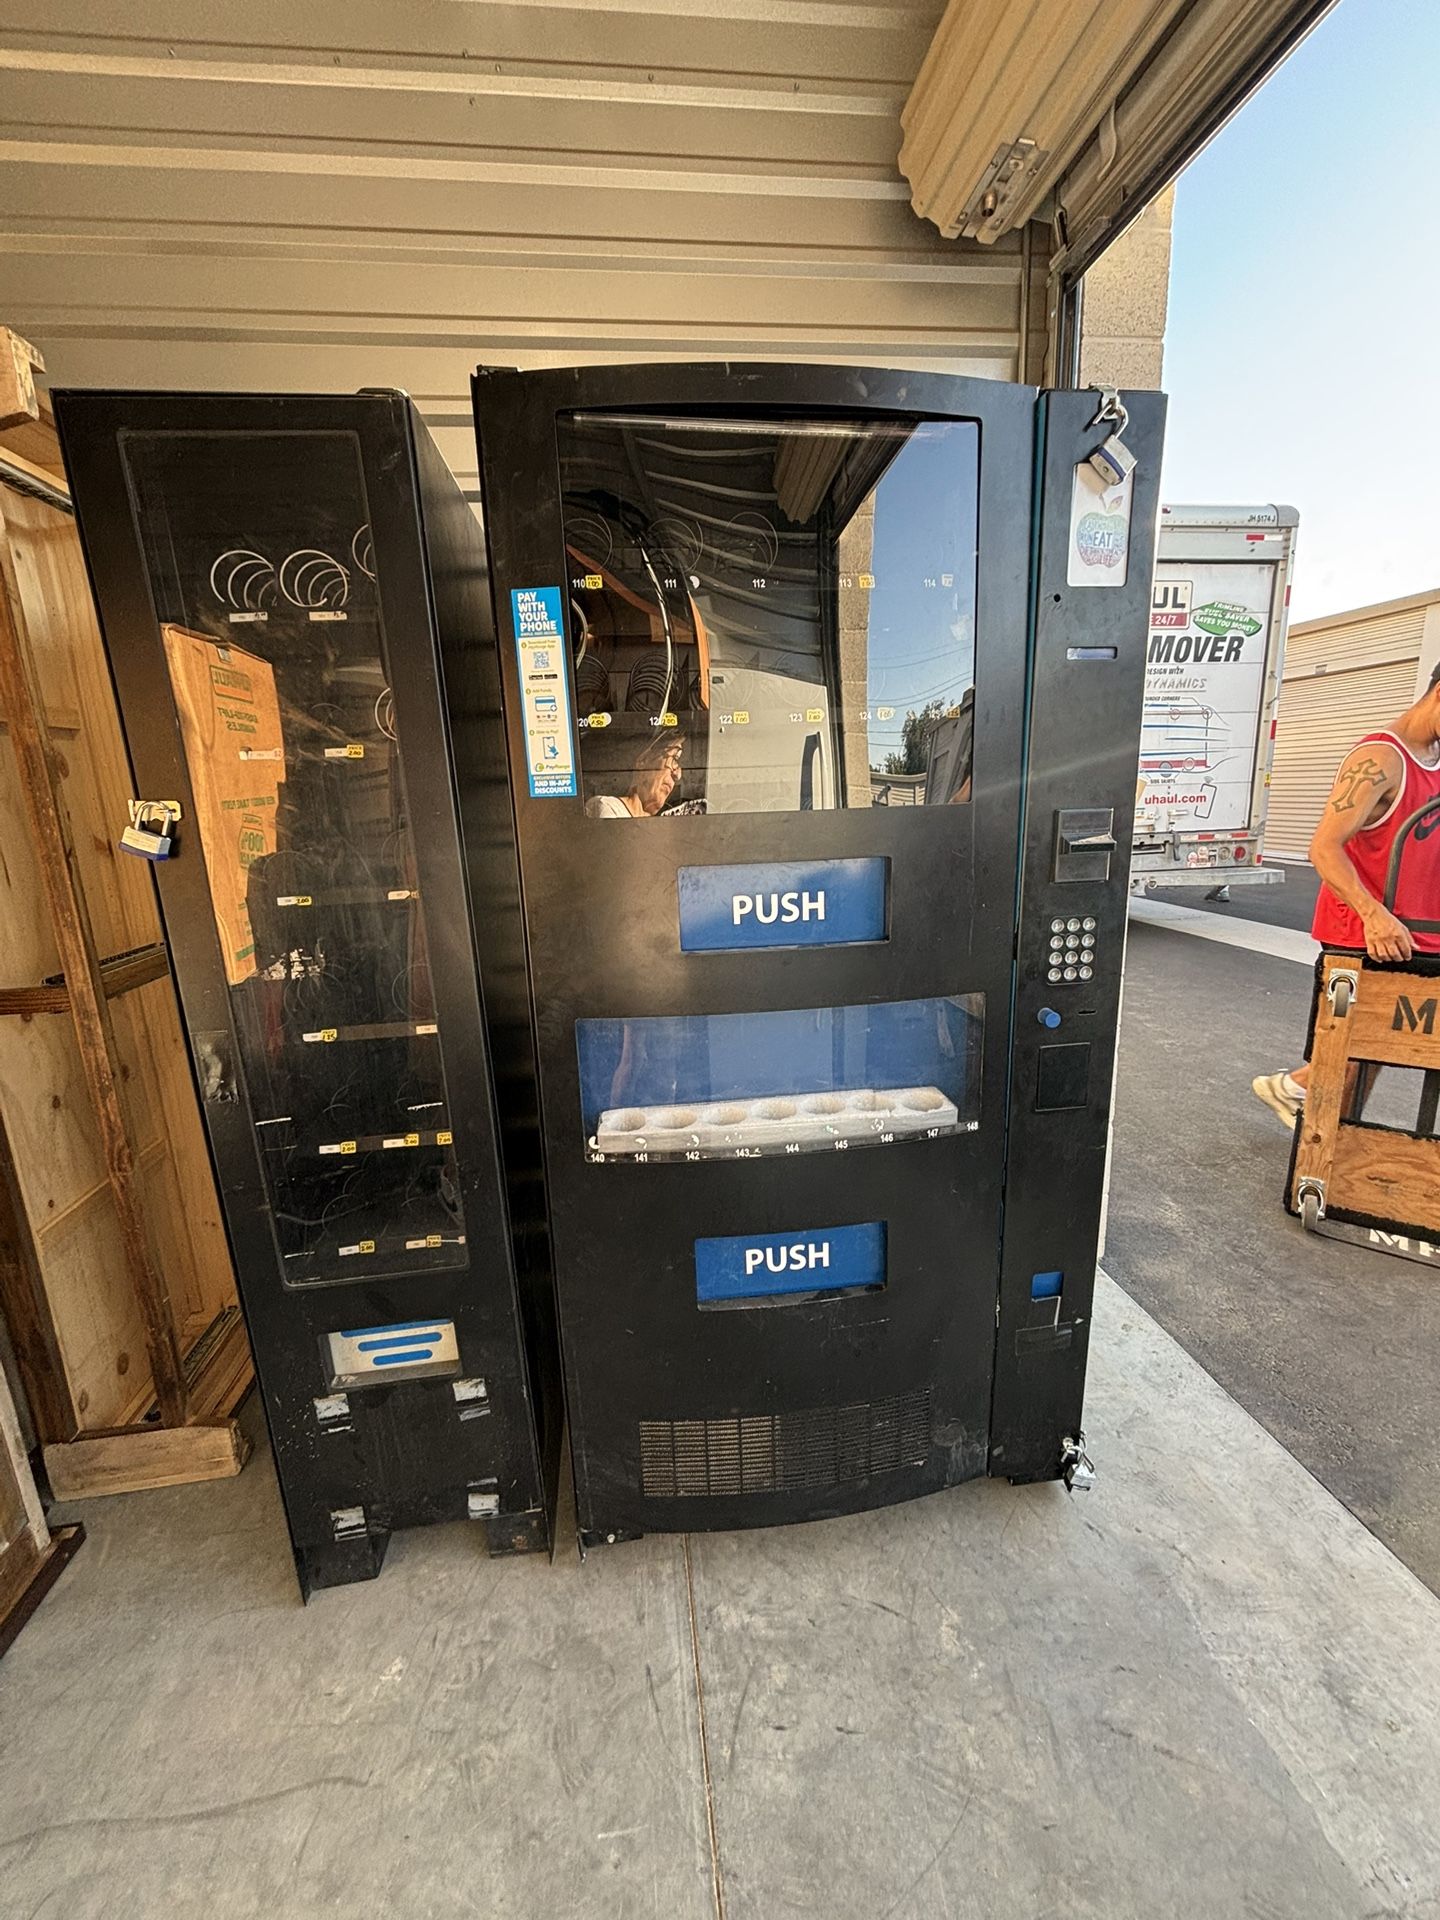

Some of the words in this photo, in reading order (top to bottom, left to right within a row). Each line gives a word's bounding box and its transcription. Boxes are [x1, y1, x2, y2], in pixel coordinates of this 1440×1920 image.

[1093, 531, 1113, 547] EAT
[572, 579, 586, 588] 110
[665, 579, 677, 588] 111
[752, 579, 766, 588] 112
[839, 579, 852, 588] 113
[923, 578, 936, 588] 114
[517, 592, 537, 602] PAY
[518, 601, 545, 612] WITH
[519, 611, 548, 621] YOUR
[1155, 615, 1176, 625] 24/7
[520, 620, 557, 632] PHONE
[1195, 615, 1216, 625] SAVES
[1216, 618, 1231, 628] YOU
[1231, 621, 1255, 632] MONEY
[1147, 635, 1244, 663] MOVER
[720, 714, 733, 724] 122
[789, 713, 803, 722] 123
[860, 712, 872, 720] 124
[534, 786, 572, 794] DISCOUNTS
[1144, 794, 1207, 805] uhaul.com
[732, 890, 825, 925] PUSH
[1392, 994, 1438, 1035] M
[966, 1121, 979, 1131] 148
[927, 1128, 938, 1138] 147
[880, 1134, 893, 1143] 146
[785, 1143, 799, 1153] 144
[834, 1140, 848, 1149] 145
[634, 1153, 648, 1162] 141
[686, 1152, 700, 1160] 142
[736, 1148, 750, 1157] 143
[591, 1154, 605, 1163] 140
[745, 1242, 830, 1275] PUSH
